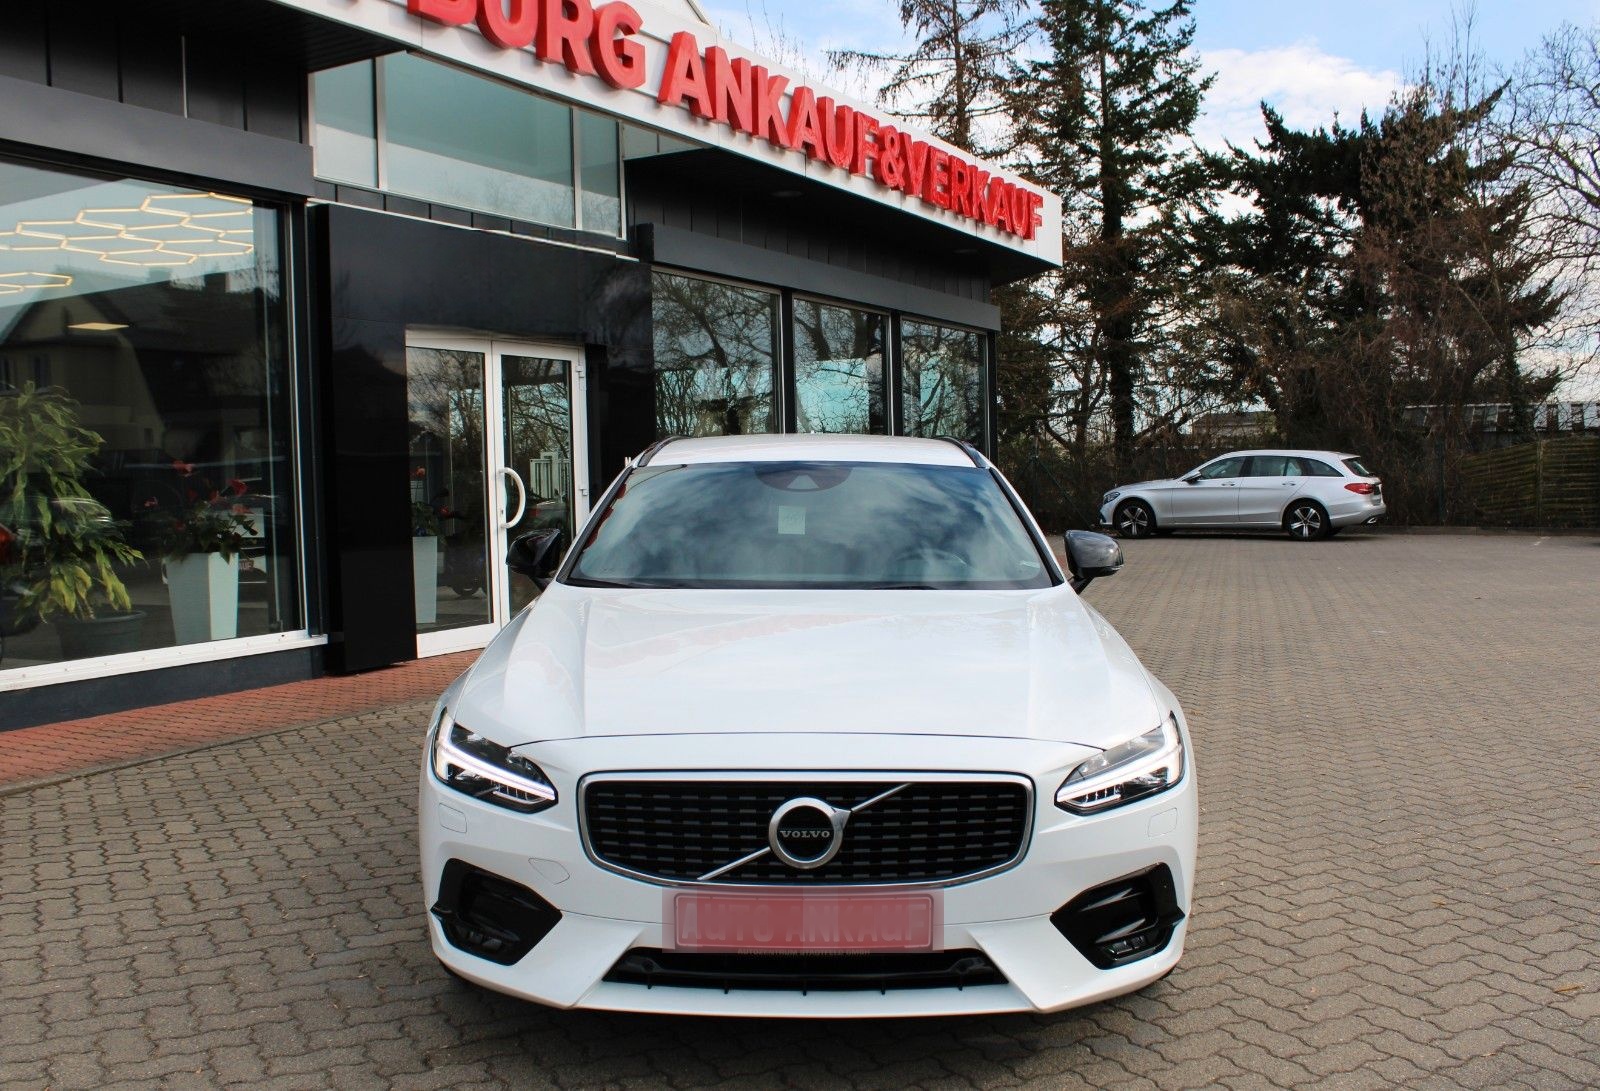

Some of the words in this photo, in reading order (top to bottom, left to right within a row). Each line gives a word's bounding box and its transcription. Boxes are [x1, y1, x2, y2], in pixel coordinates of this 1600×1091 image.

[656, 31, 1044, 241] ANKAUF&VERKAUF
[779, 830, 831, 839] VOLVO
[681, 902, 775, 942] AUTO
[785, 902, 927, 943] ANKAUF
